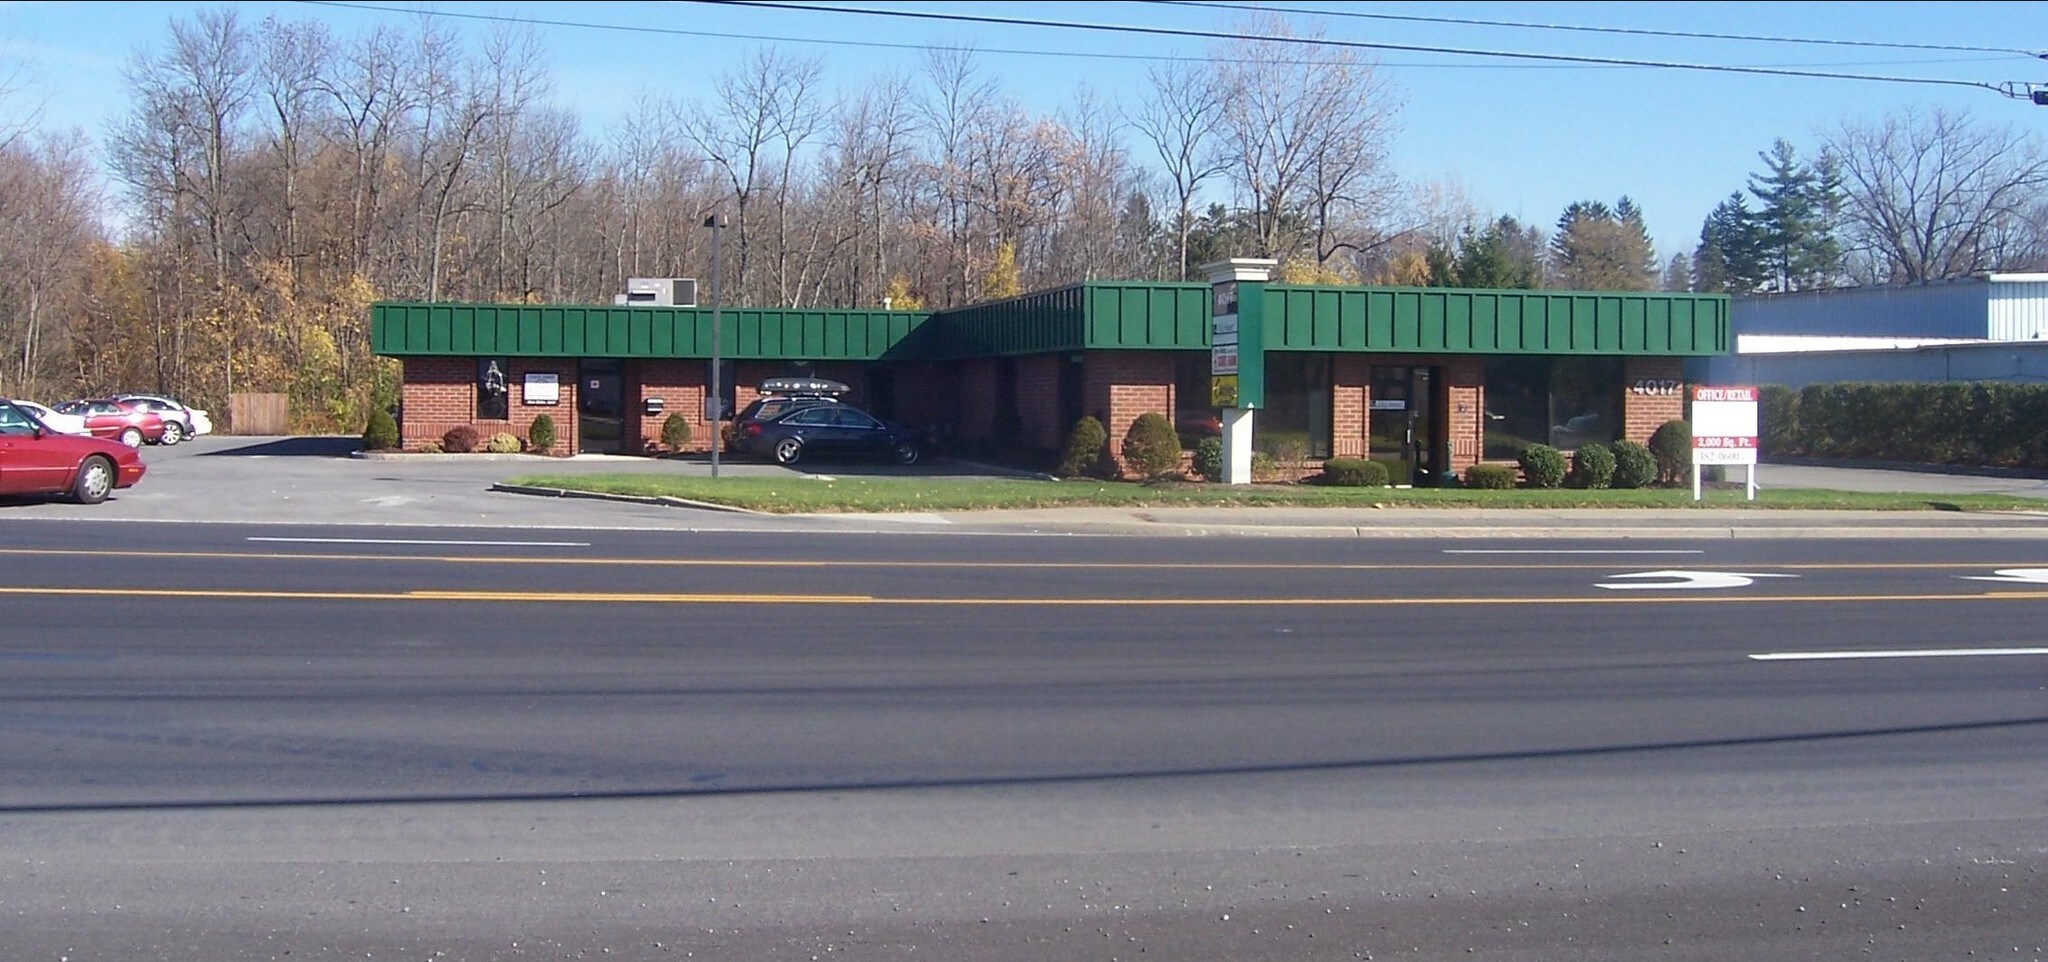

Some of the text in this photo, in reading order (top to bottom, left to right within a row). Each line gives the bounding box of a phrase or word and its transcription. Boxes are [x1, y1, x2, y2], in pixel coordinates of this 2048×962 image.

[1633, 379, 1675, 395] 4017
[1697, 389, 1753, 400] OFFICE/RETAIL
[1722, 437, 1737, 448] Sq.
[1738, 437, 1753, 447] Ft.
